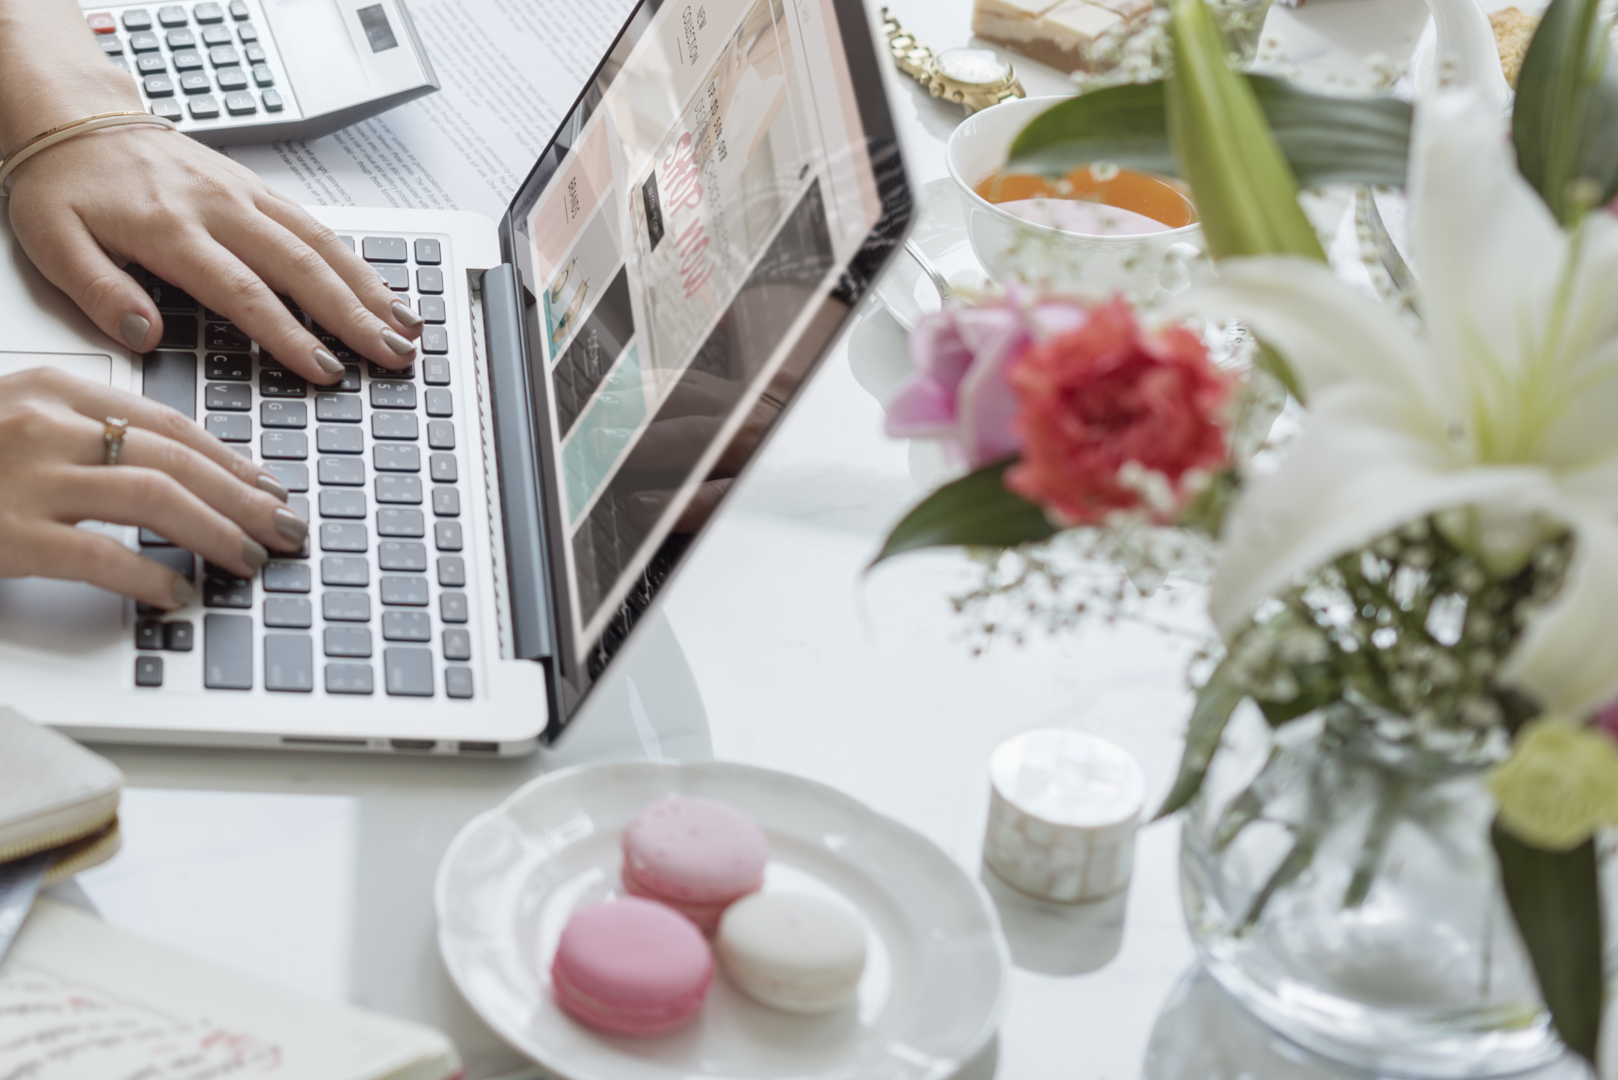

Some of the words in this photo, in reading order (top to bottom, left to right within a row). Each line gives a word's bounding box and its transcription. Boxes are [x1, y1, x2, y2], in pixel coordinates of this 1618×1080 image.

[94, 16, 110, 26] C
[696, 4, 707, 31] NEW
[173, 34, 189, 42] 7
[682, 5, 699, 66] COLLECTION
[137, 37, 153, 45] 4
[143, 58, 160, 67] 5
[179, 55, 196, 64] 8
[150, 80, 167, 89] 6
[187, 76, 203, 85] 9
[708, 81, 716, 98] UP
[711, 98, 719, 116] TO
[714, 116, 723, 139] 50%
[662, 131, 703, 218] SHOP
[568, 176, 580, 219] BRANDS
[424, 246, 432, 255] esc
[269, 403, 282, 411] G
[270, 433, 282, 441] H
